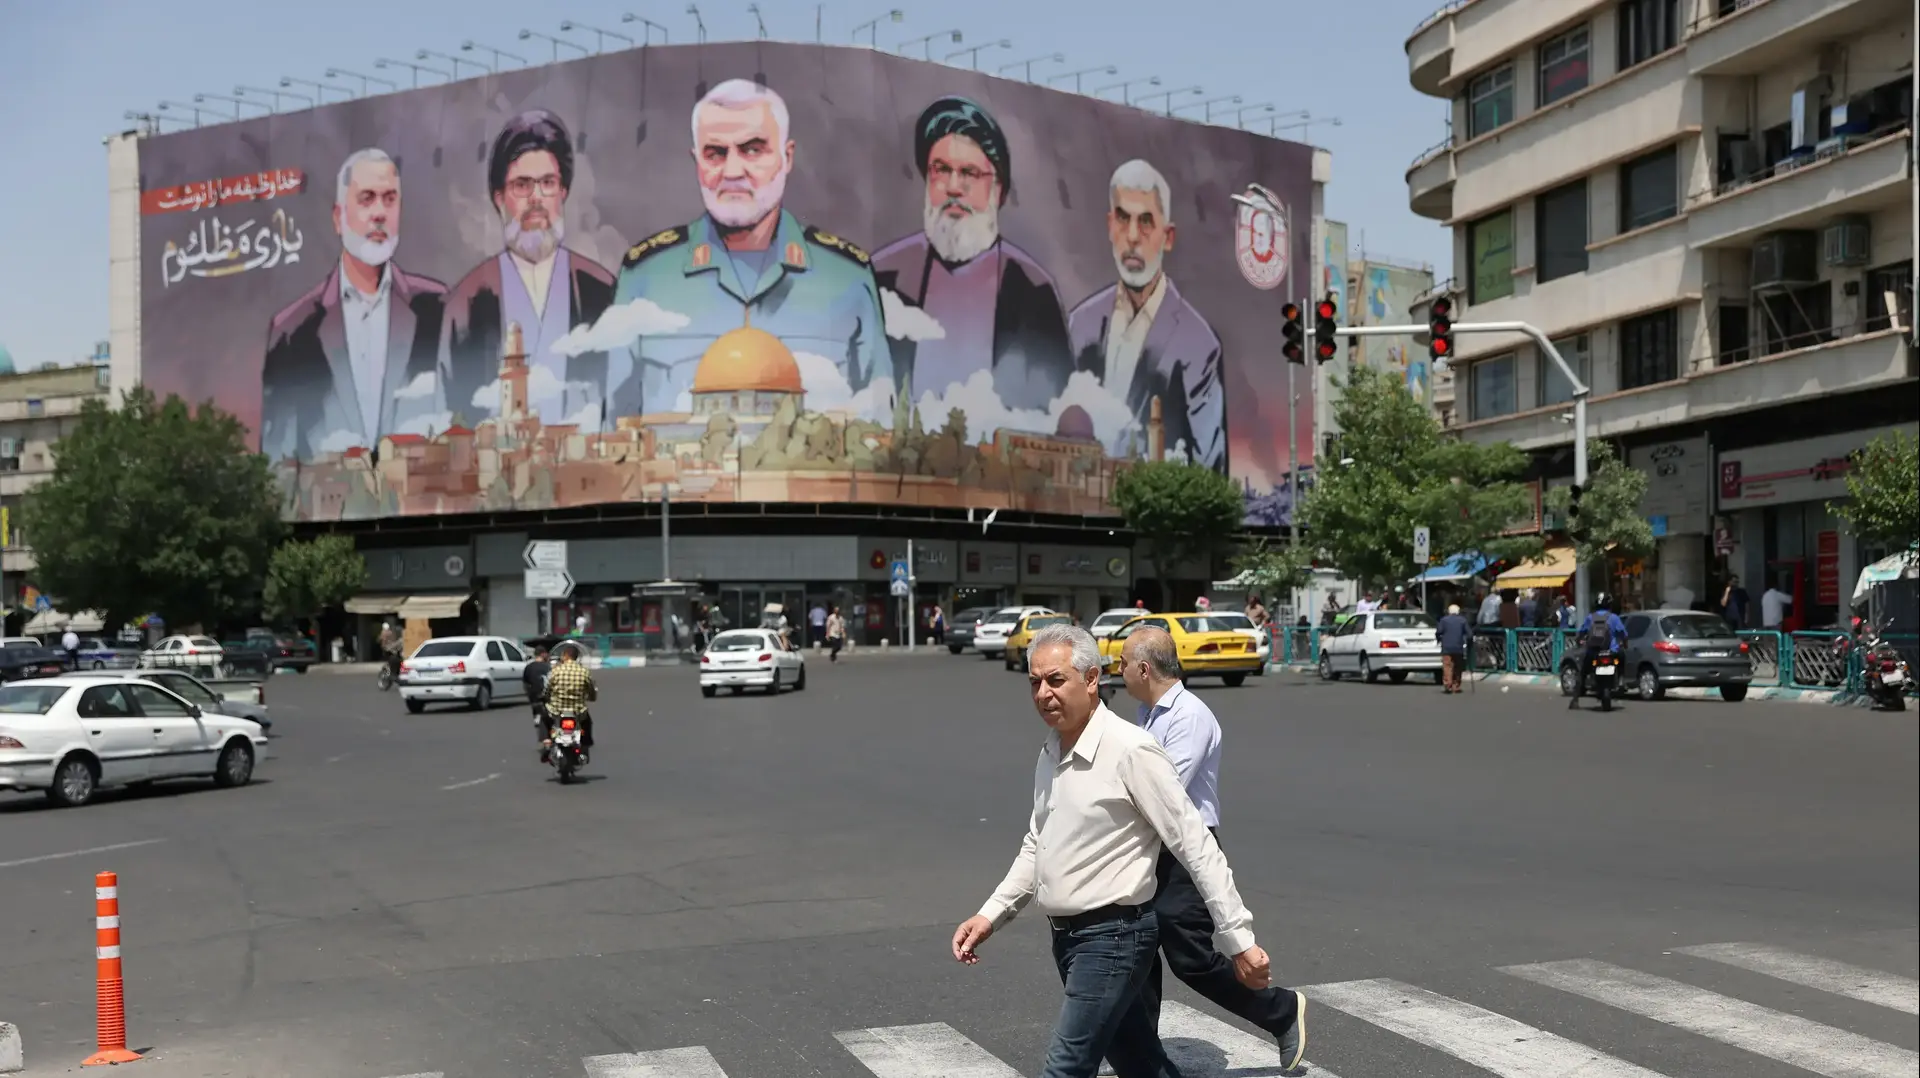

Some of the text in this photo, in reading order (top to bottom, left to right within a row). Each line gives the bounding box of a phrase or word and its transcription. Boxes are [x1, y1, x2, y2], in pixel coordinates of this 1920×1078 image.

[157, 168, 301, 212] خدا وظیفه ما را نوشت
